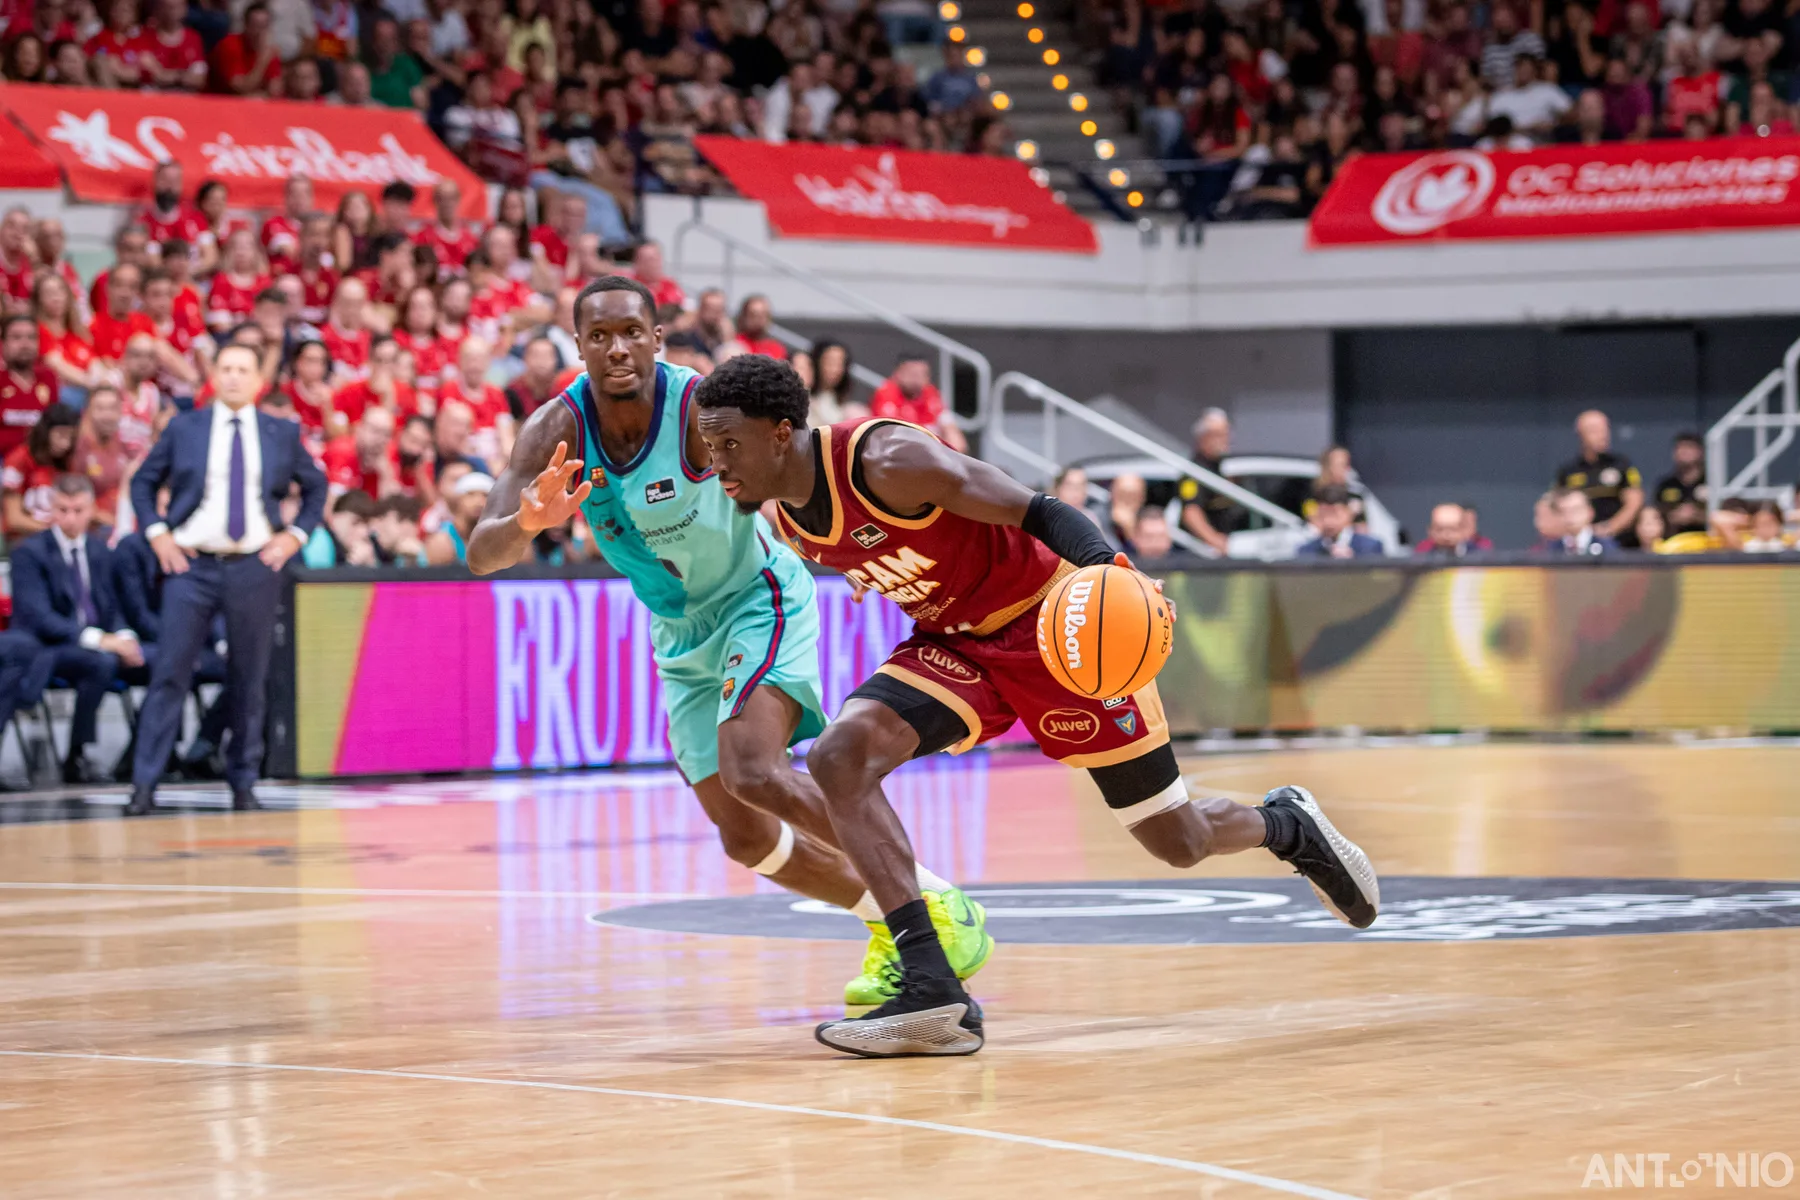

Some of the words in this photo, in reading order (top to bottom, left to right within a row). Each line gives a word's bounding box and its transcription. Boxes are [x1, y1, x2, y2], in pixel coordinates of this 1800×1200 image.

[1508, 163, 1573, 196] OC
[1064, 580, 1095, 670] Wilson
[924, 648, 972, 678] Juver
[1050, 718, 1092, 734] Juver
